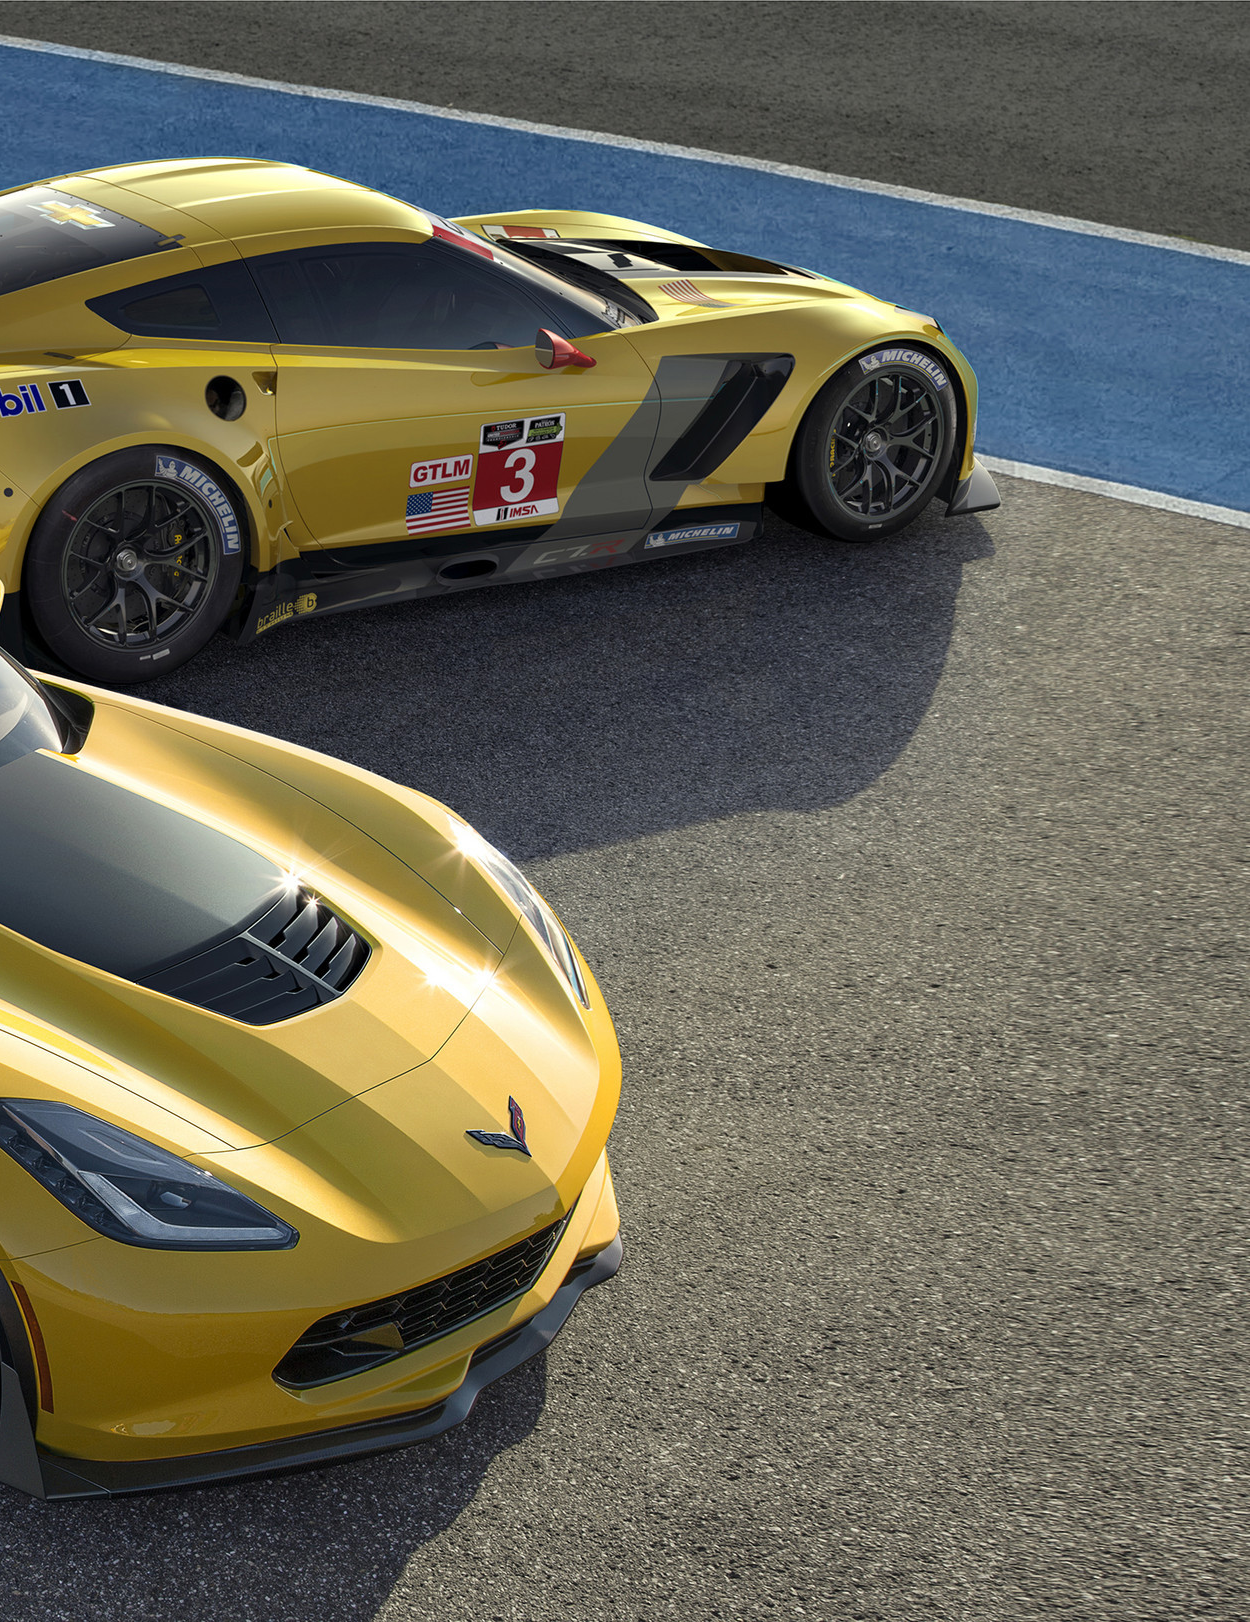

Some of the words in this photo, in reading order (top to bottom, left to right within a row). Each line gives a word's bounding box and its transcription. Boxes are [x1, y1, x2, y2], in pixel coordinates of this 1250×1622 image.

[881, 350, 947, 386] MICHELIN
[496, 423, 517, 431] TUDOR
[413, 459, 470, 482] GTLM
[500, 448, 536, 503] 3
[179, 465, 239, 549] MICHELIN
[509, 505, 539, 518] IMSA
[667, 526, 734, 540] MICHELIN
[257, 602, 293, 629] braille
